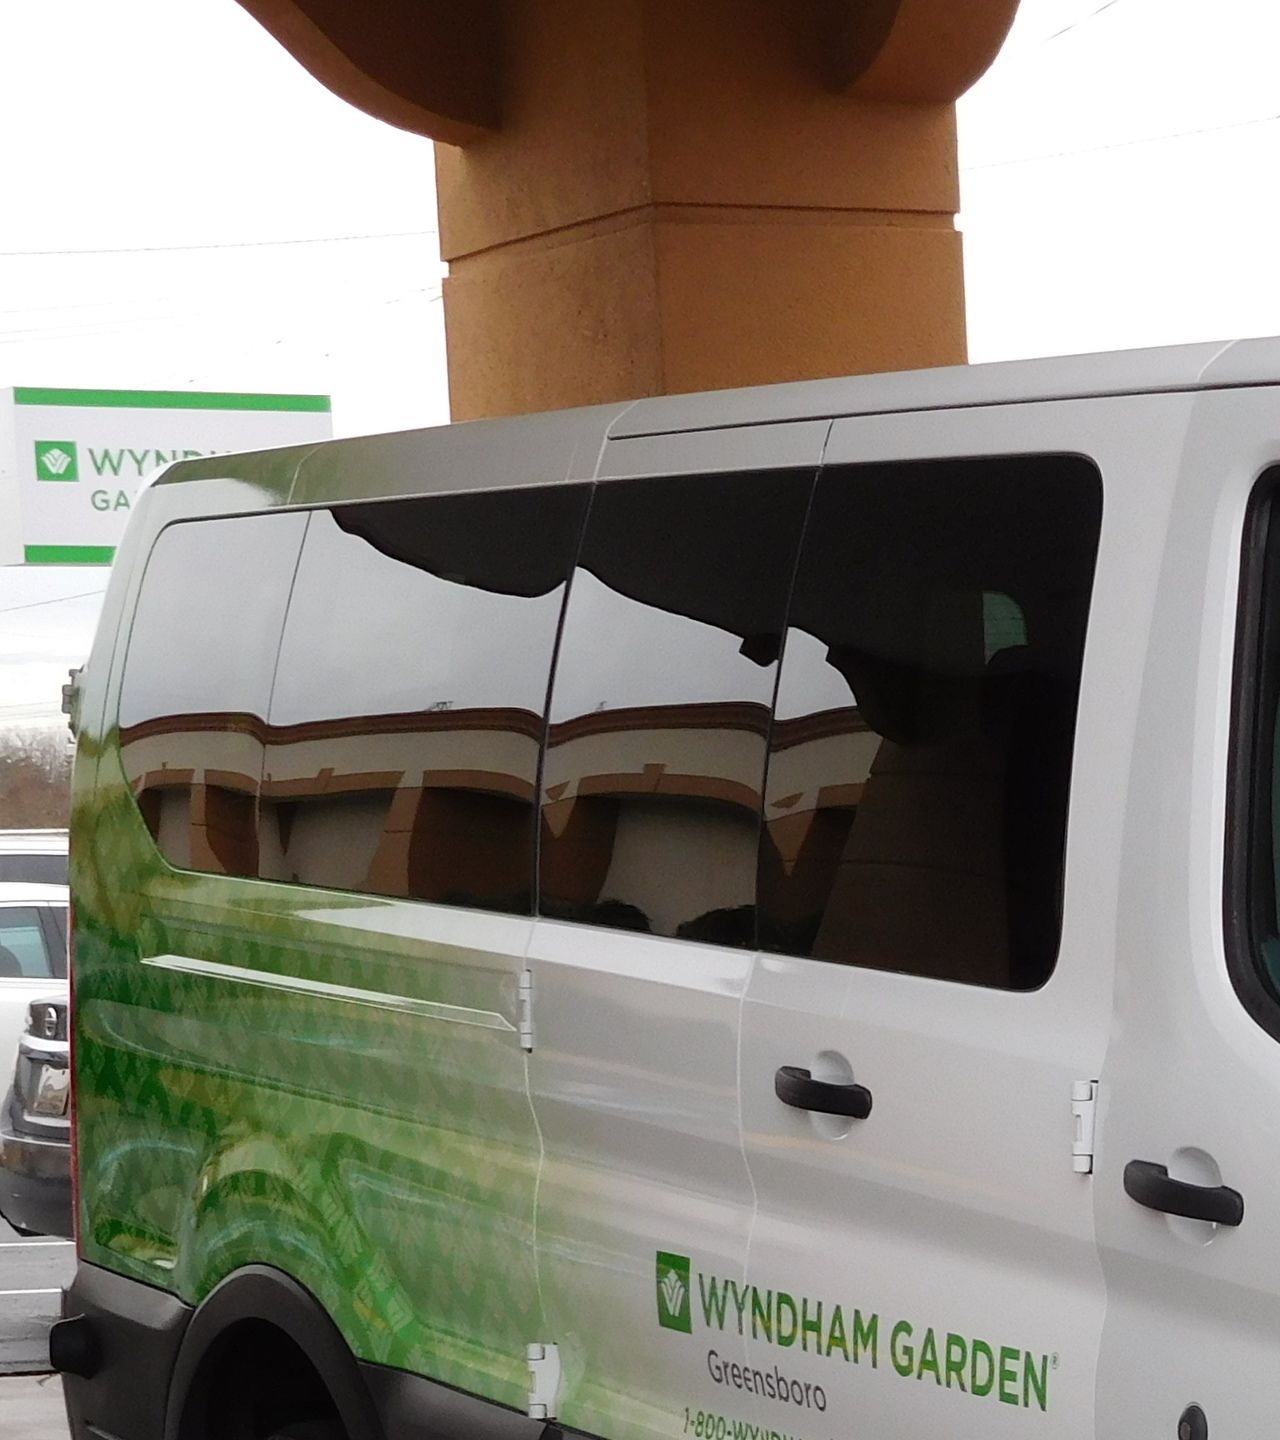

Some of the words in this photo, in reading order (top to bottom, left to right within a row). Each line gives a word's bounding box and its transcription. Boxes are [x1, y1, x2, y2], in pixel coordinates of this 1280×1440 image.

[90, 489, 137, 512] GA
[698, 1273, 879, 1369] WYNDHAM
[890, 1320, 1048, 1411] GARDEN
[707, 1349, 827, 1412] Greensboro
